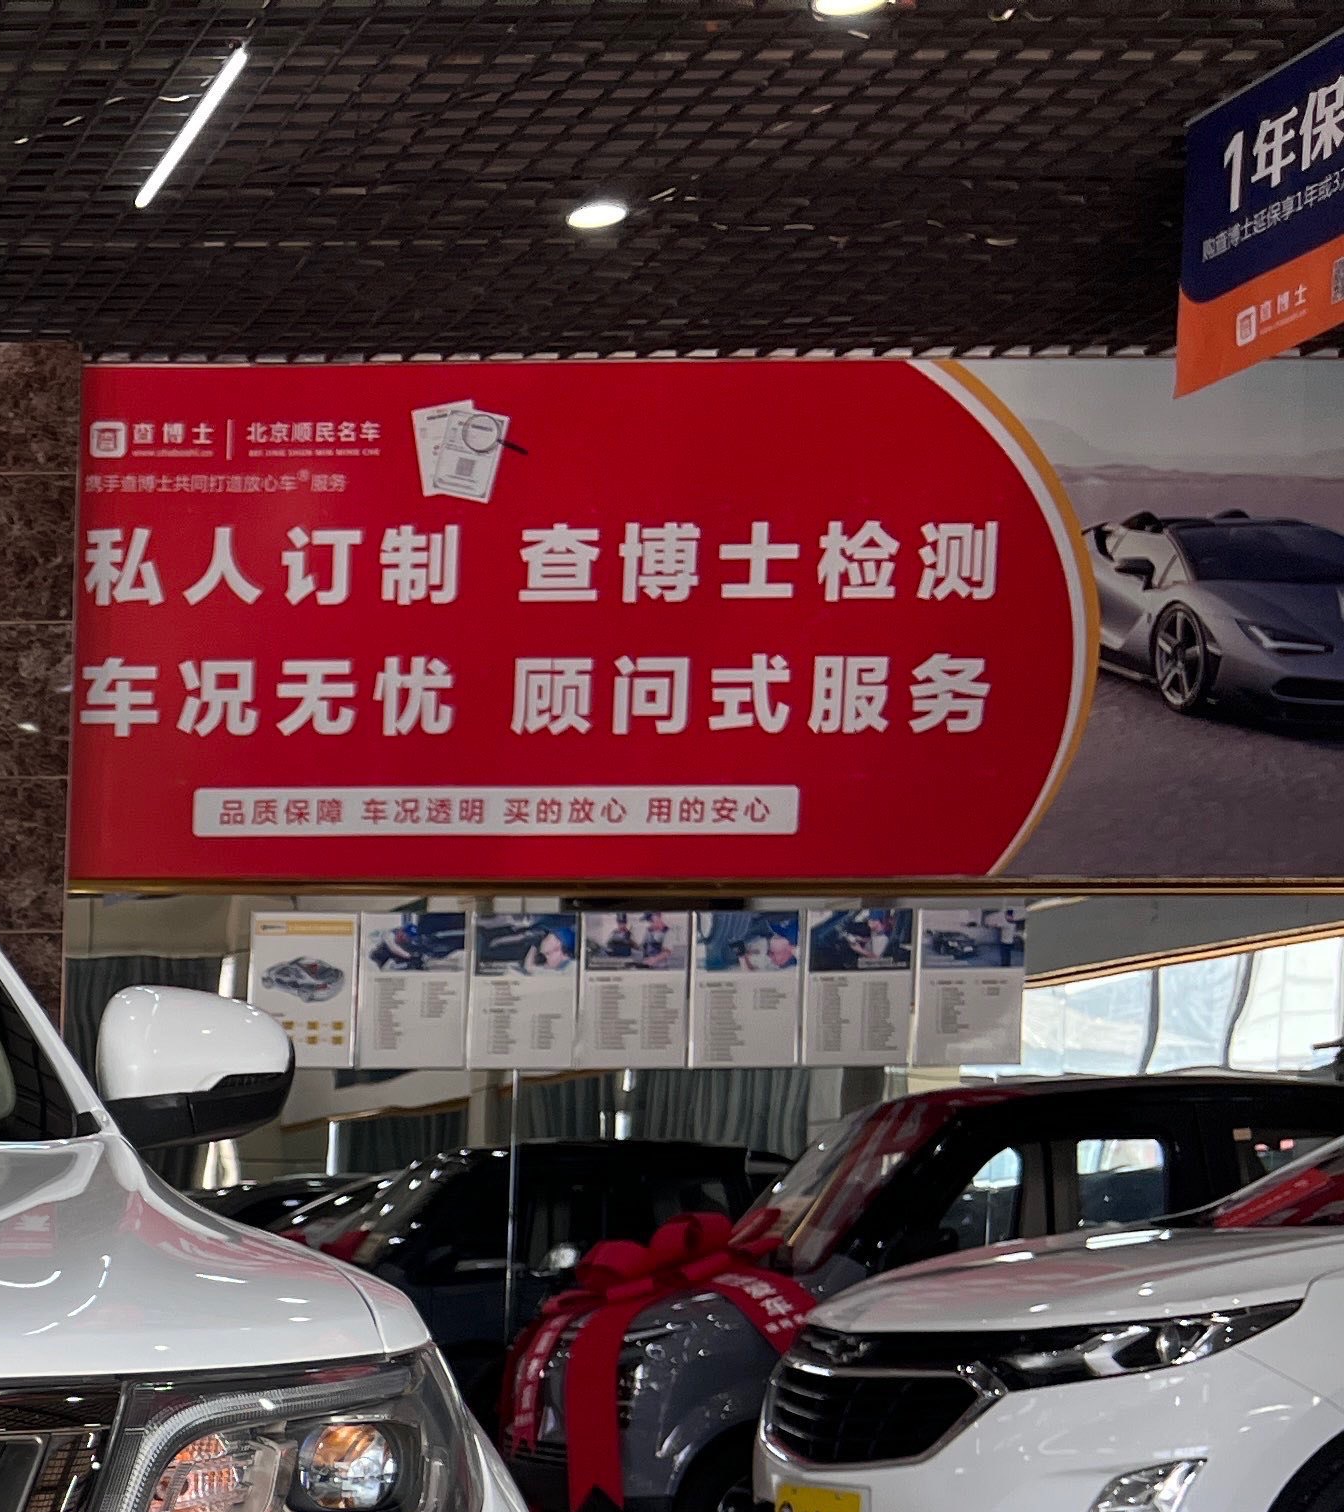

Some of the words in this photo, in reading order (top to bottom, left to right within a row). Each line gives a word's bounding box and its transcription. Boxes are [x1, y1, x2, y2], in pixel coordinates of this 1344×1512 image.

[132, 421, 215, 444] 查博士
[247, 422, 381, 443] 北京顺民名车
[84, 523, 460, 606] 私人订制
[518, 520, 999, 603] 查博士检测
[79, 655, 455, 737] 车况无忧
[510, 652, 992, 735] 顾问式服务
[219, 799, 344, 826] 品质保障
[361, 798, 485, 825] 车况透明
[503, 798, 628, 825] 买的放心
[646, 797, 771, 824] 用的安心
